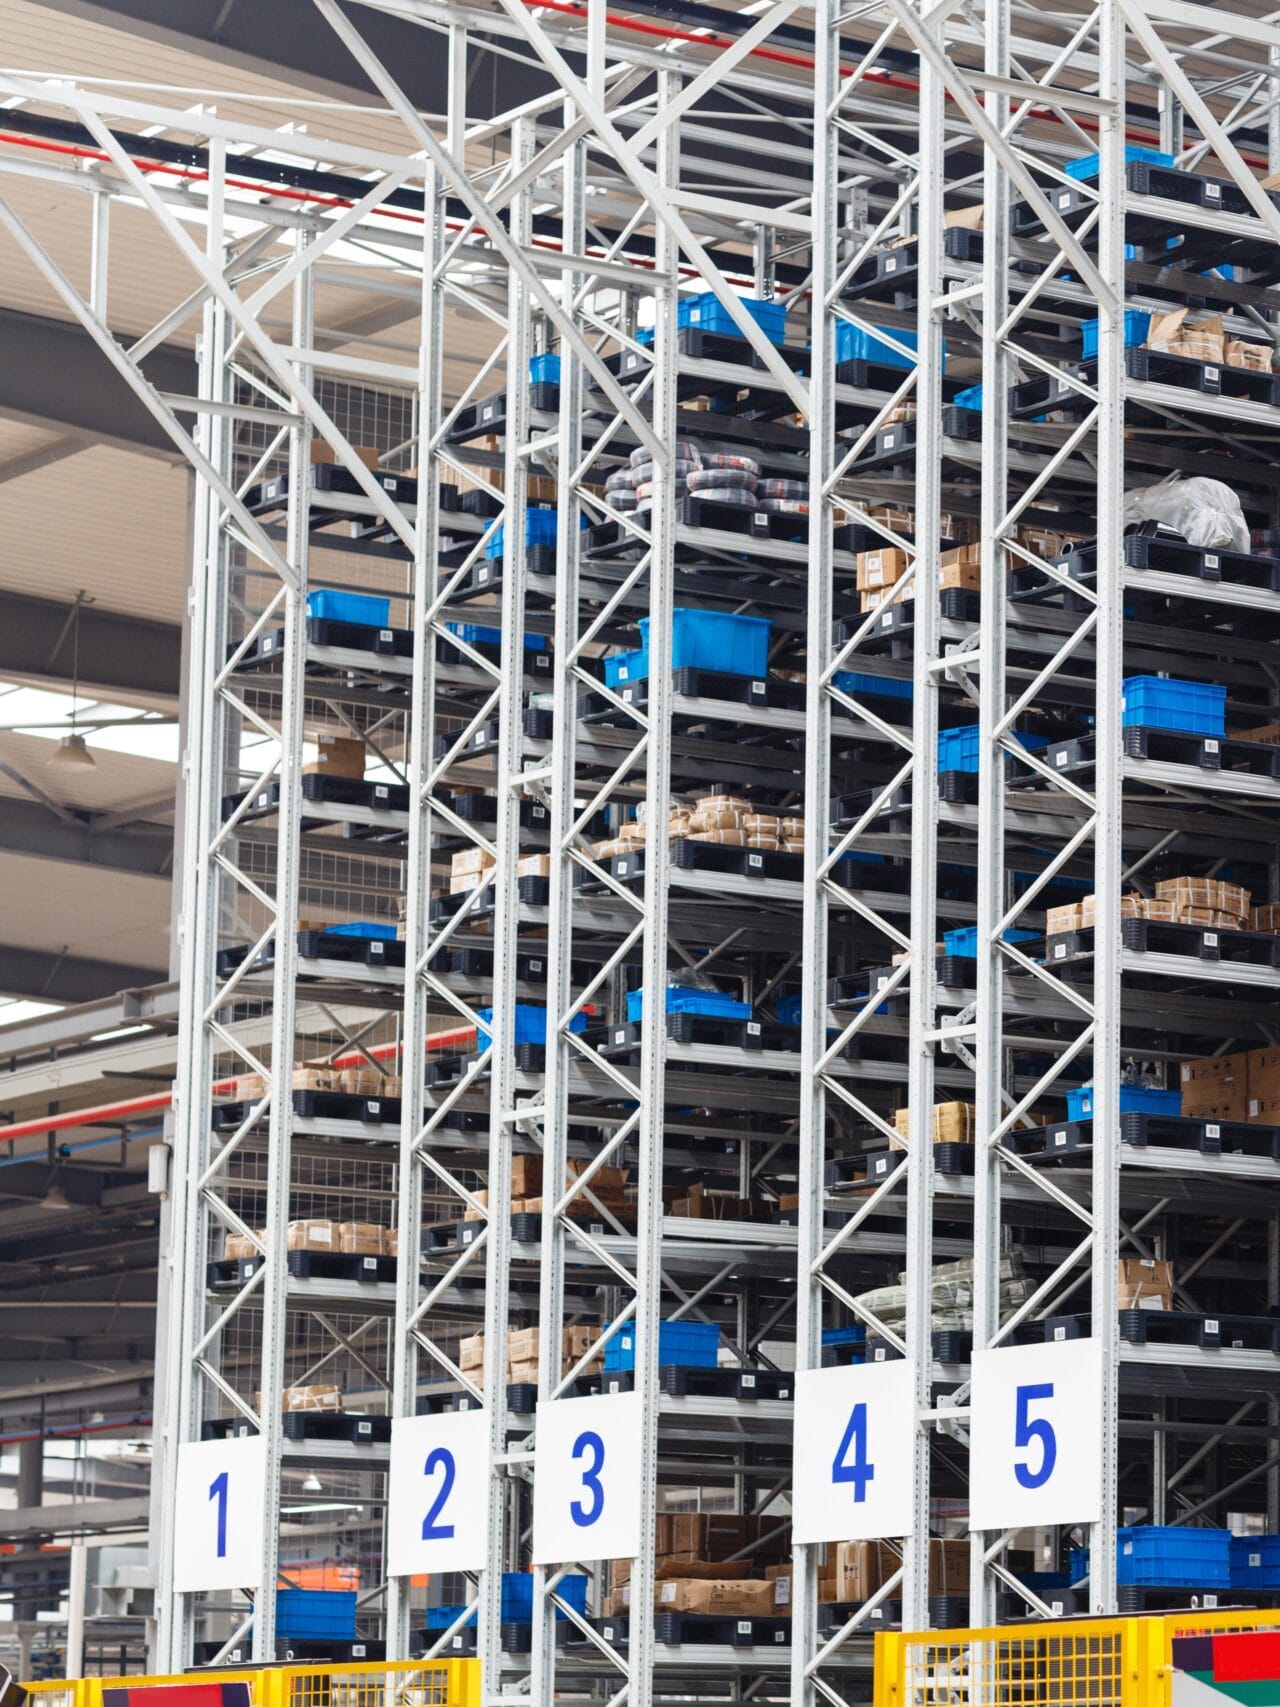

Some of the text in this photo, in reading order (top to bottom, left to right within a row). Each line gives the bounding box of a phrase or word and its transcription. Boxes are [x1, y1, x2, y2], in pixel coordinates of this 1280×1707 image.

[570, 1431, 605, 1527] 3
[832, 1403, 874, 1503] 4
[1014, 1383, 1057, 1489] 5
[209, 1472, 228, 1557] 1
[422, 1447, 456, 1540] 2
